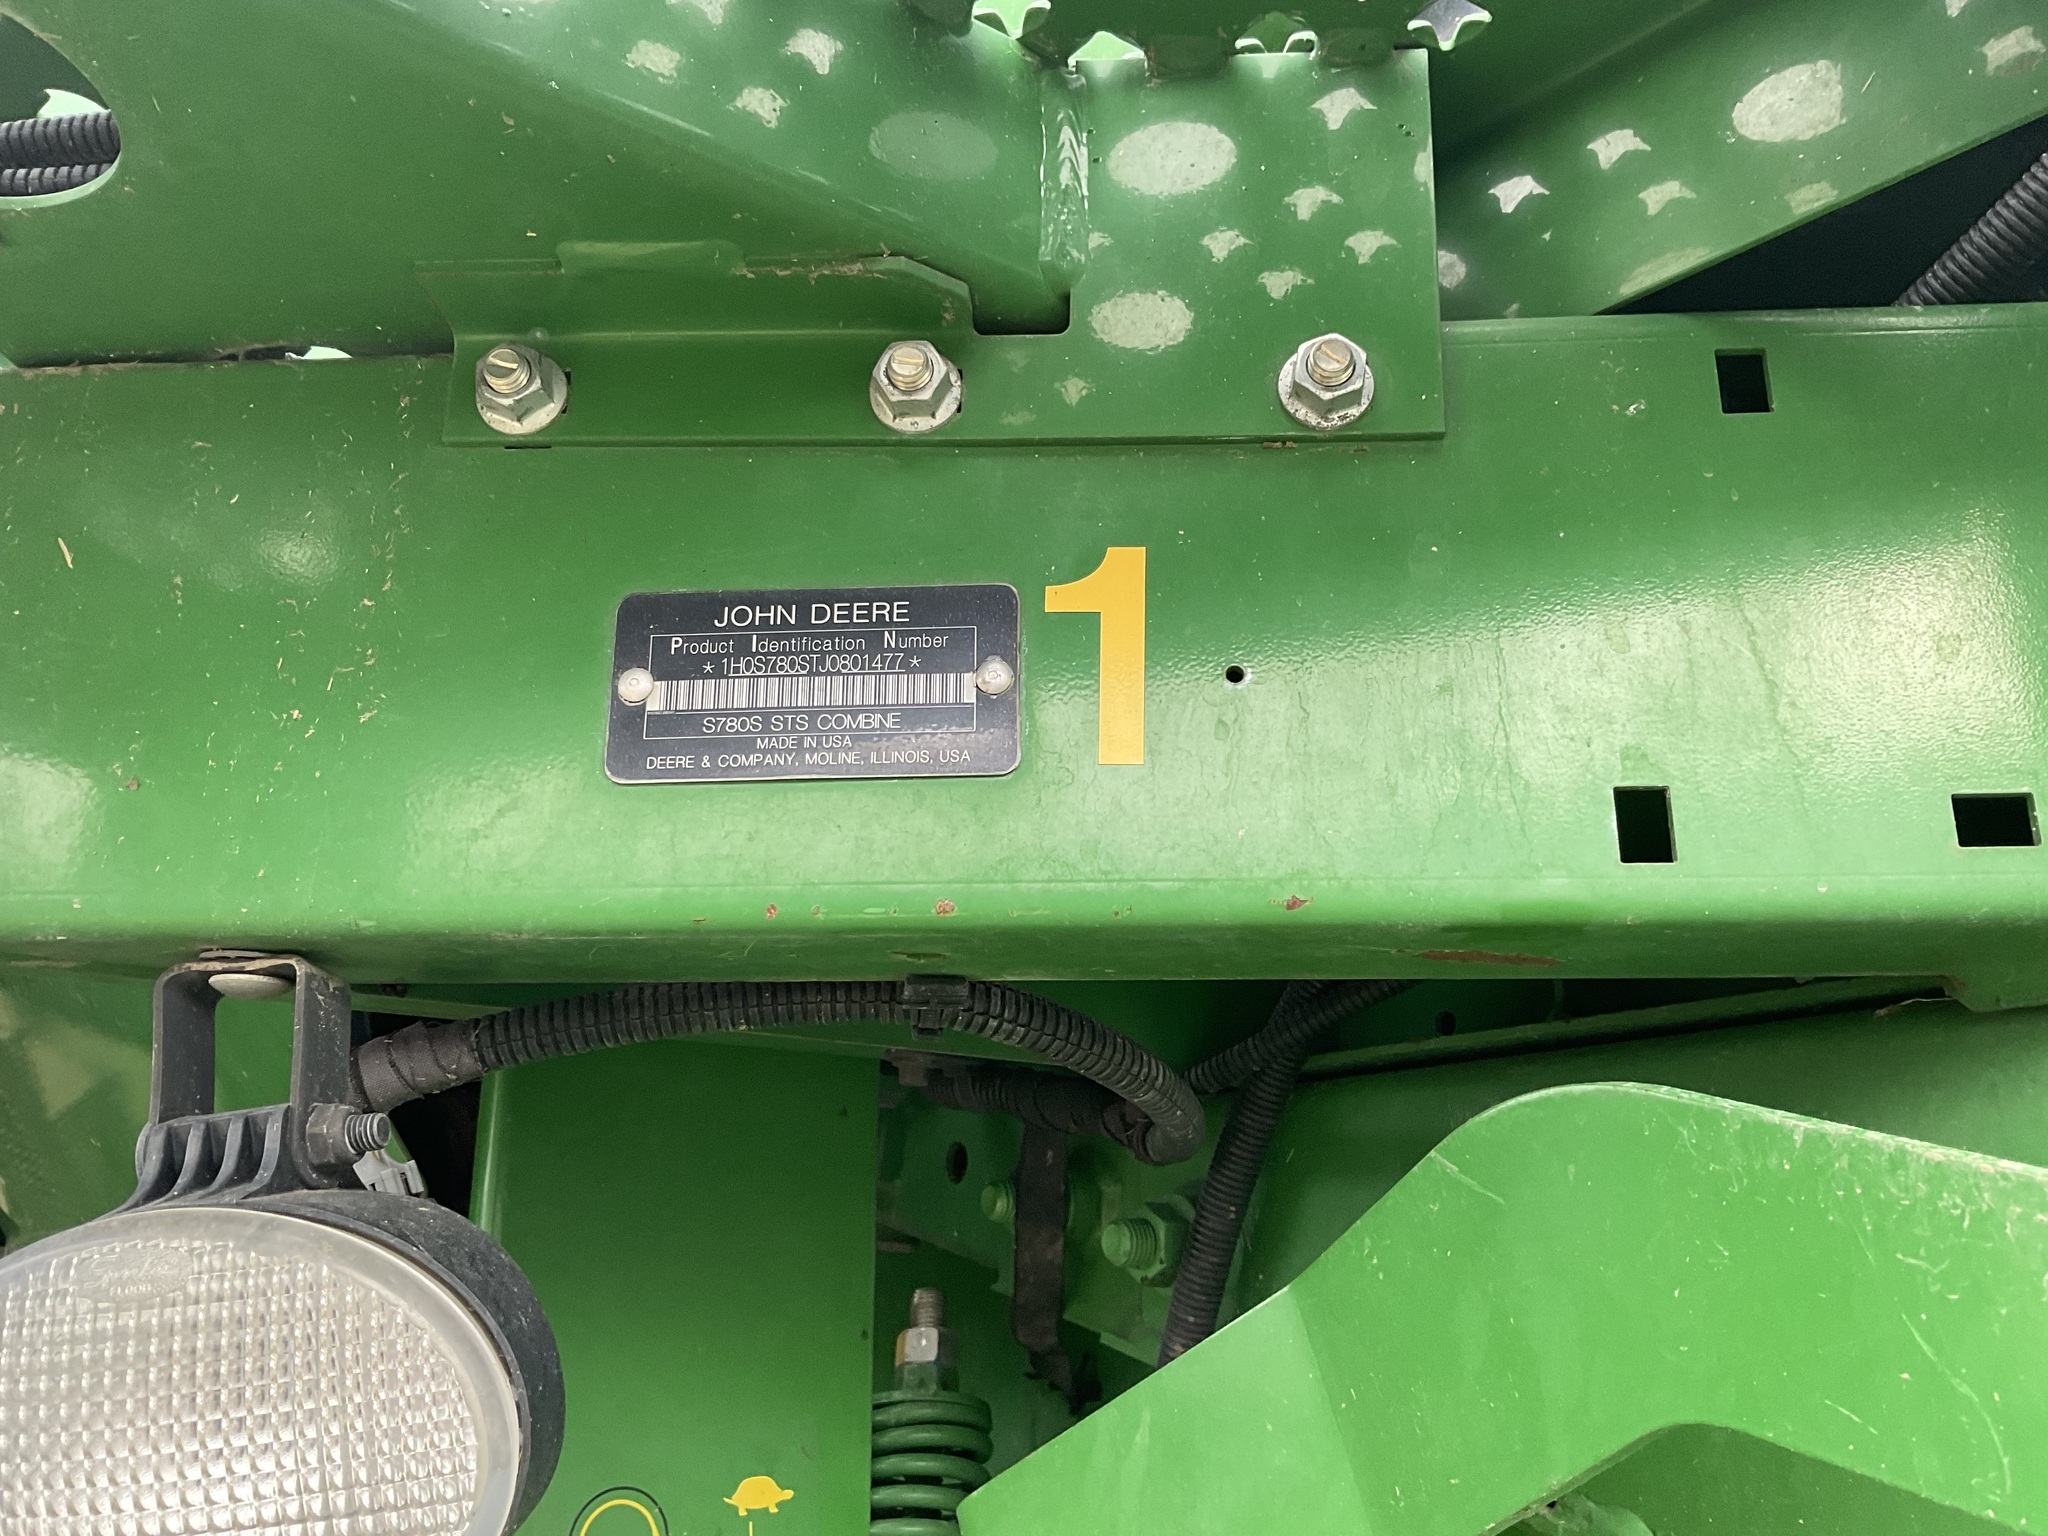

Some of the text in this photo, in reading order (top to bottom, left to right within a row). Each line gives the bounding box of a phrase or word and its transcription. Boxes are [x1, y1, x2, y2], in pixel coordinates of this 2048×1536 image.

[714, 601, 910, 627] JOHN DEERE
[671, 630, 949, 655] Product Identification Number
[1044, 546, 1146, 765] 1
[702, 713, 902, 733] S780S STS COMBINE
[756, 735, 852, 749] MADE IN USA
[646, 749, 971, 769] DEERE & COMPANY, MOLINE, ILLINOIS, USA
